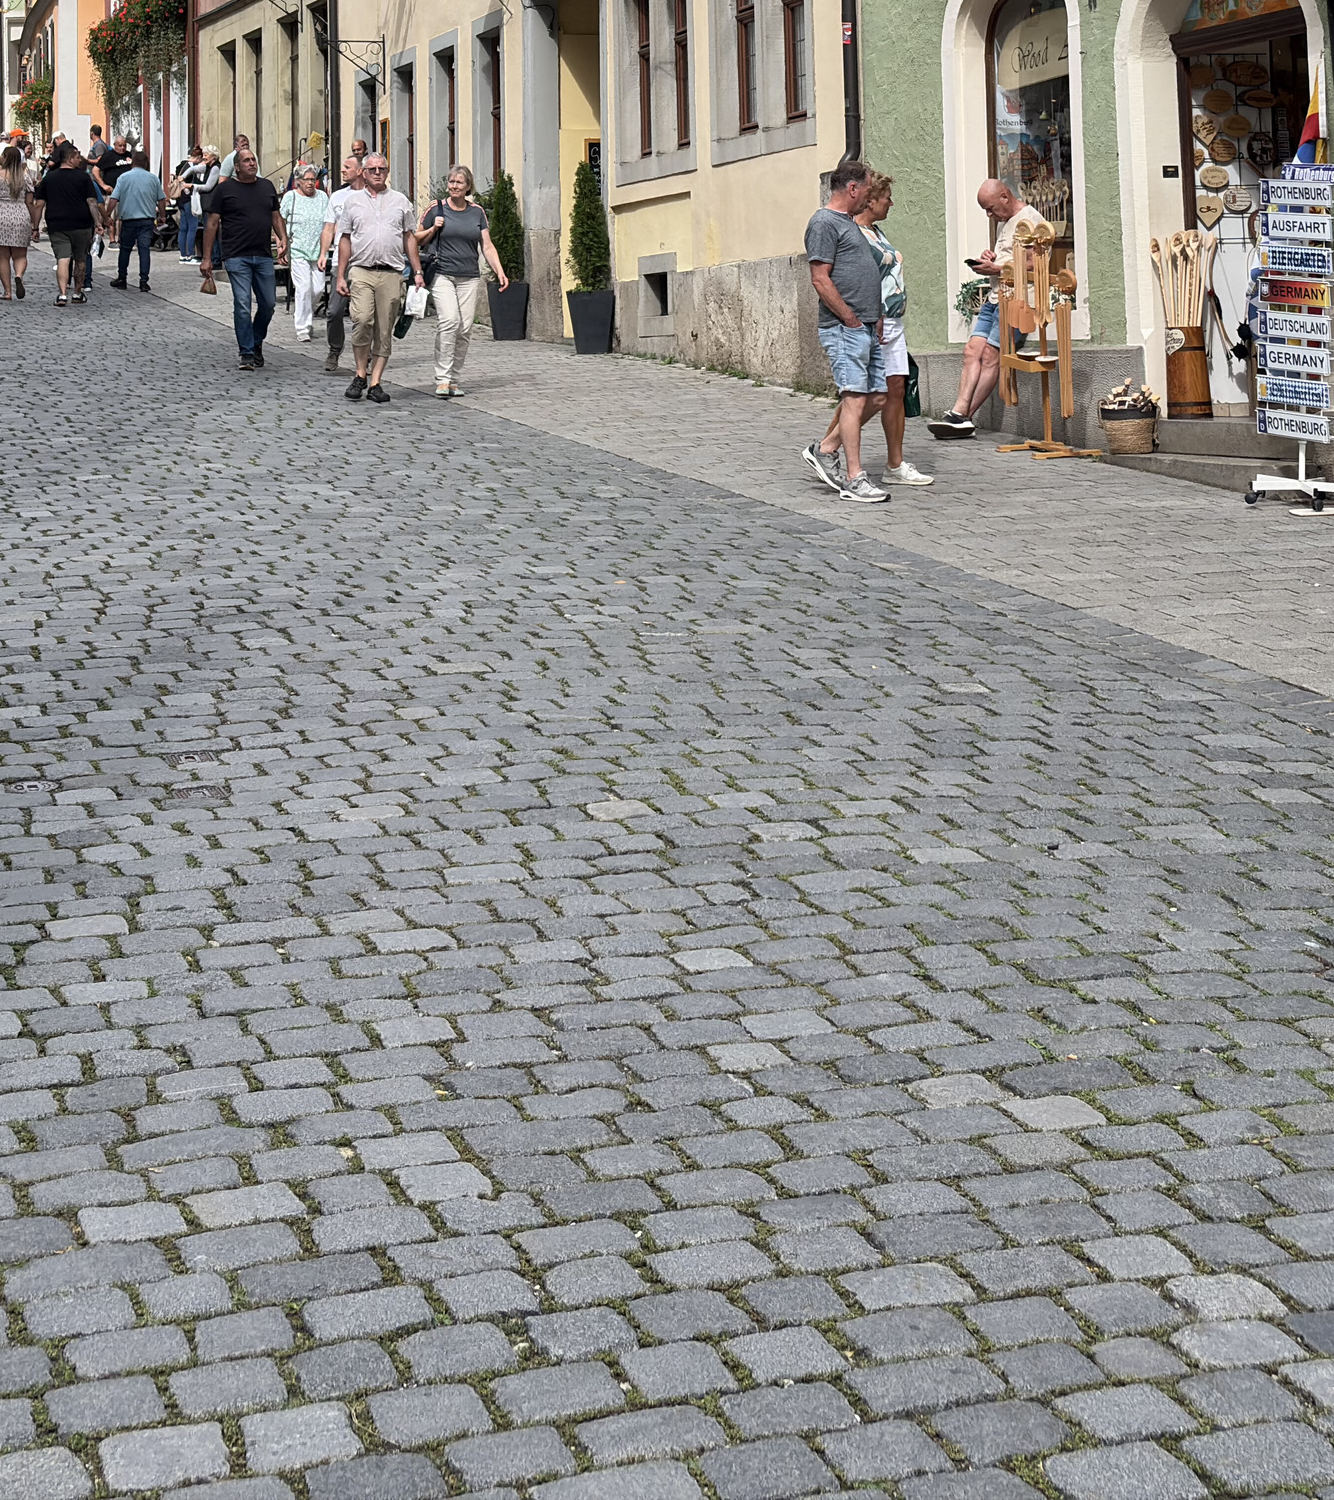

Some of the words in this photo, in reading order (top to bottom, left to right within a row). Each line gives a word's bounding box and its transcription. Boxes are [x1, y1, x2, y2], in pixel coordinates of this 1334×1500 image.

[1011, 36, 1049, 74] Wood
[1270, 185, 1330, 201] ROTHENBURG
[1271, 219, 1327, 234] AUSFAHRT
[1271, 249, 1326, 269] BIERGARTEN
[1271, 285, 1326, 301] GERMANY
[1268, 317, 1328, 335] DEUTSCHLAND
[1268, 350, 1325, 369] GERMANY
[1267, 415, 1327, 436] ROTHENBURG
